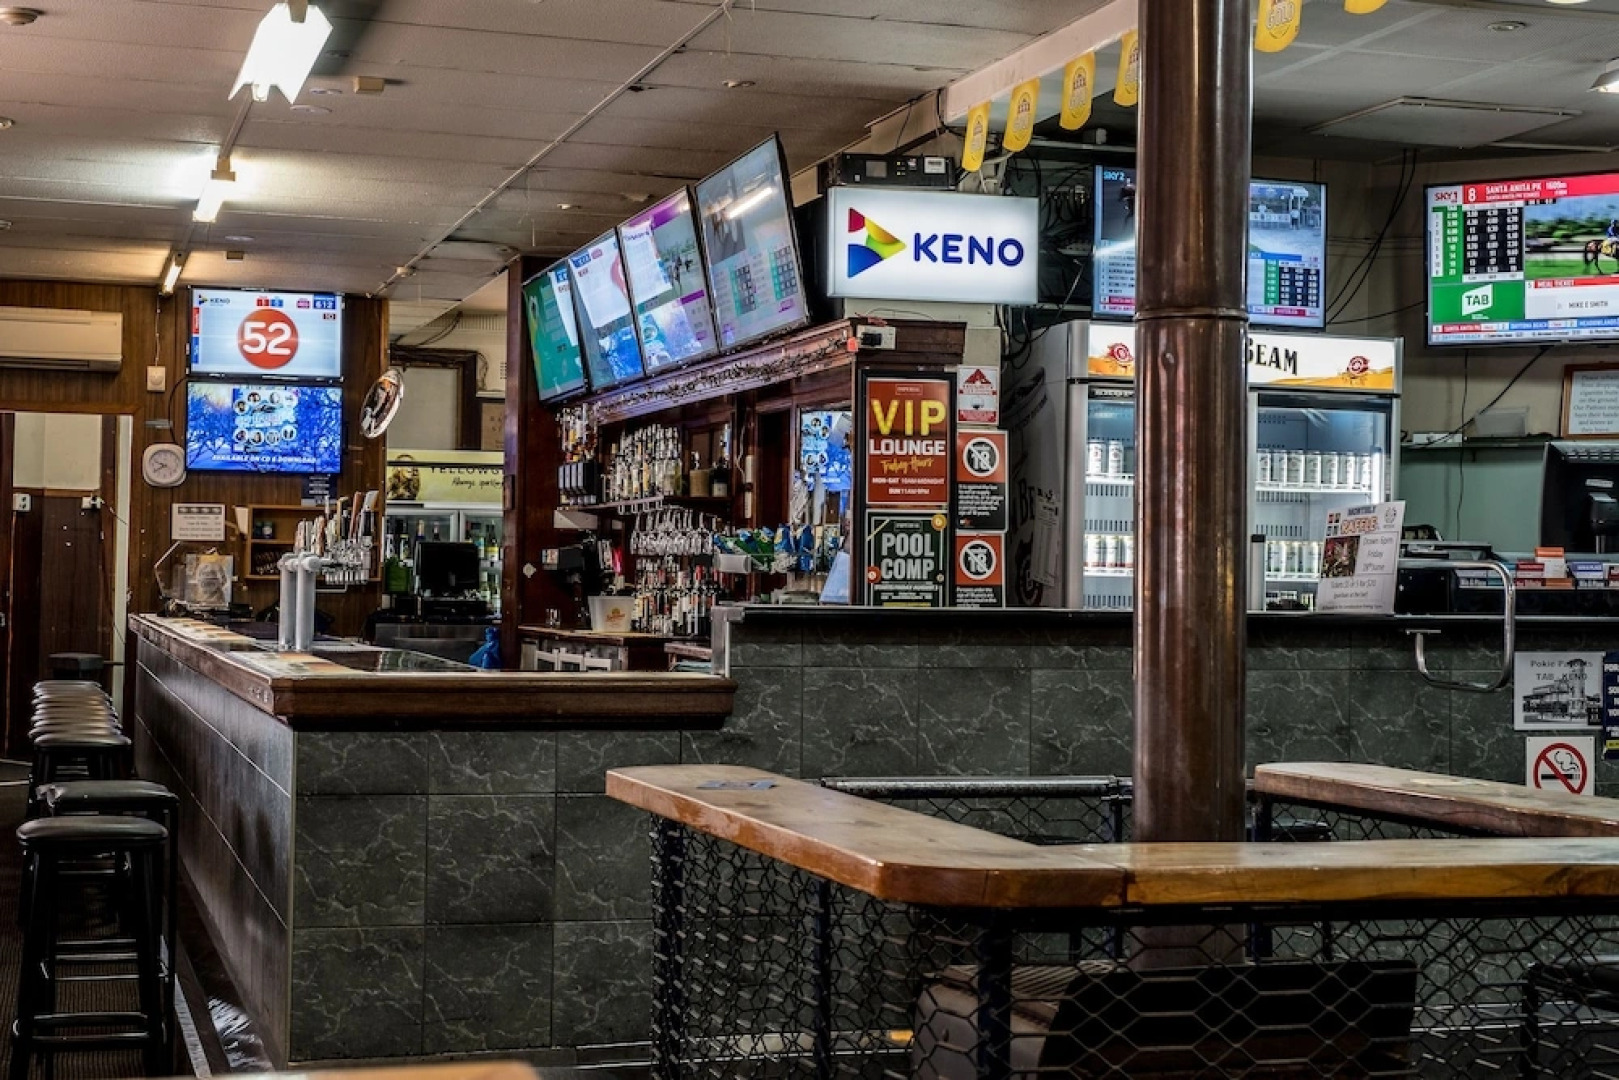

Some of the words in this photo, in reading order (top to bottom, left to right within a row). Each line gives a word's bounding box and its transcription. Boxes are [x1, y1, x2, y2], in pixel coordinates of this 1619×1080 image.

[1267, 2, 1294, 29] GOLD
[1468, 187, 1476, 201] 8
[913, 232, 1024, 267] KENO
[1465, 293, 1490, 306] TAB
[242, 321, 292, 356] 52
[870, 399, 946, 436] VIP
[869, 439, 946, 456] LOUNGE
[1341, 516, 1378, 535] RAFFLE
[881, 533, 935, 557] POOL
[880, 558, 935, 580] COMP
[1536, 673, 1555, 681] TAB
[1562, 673, 1588, 681] KENO
